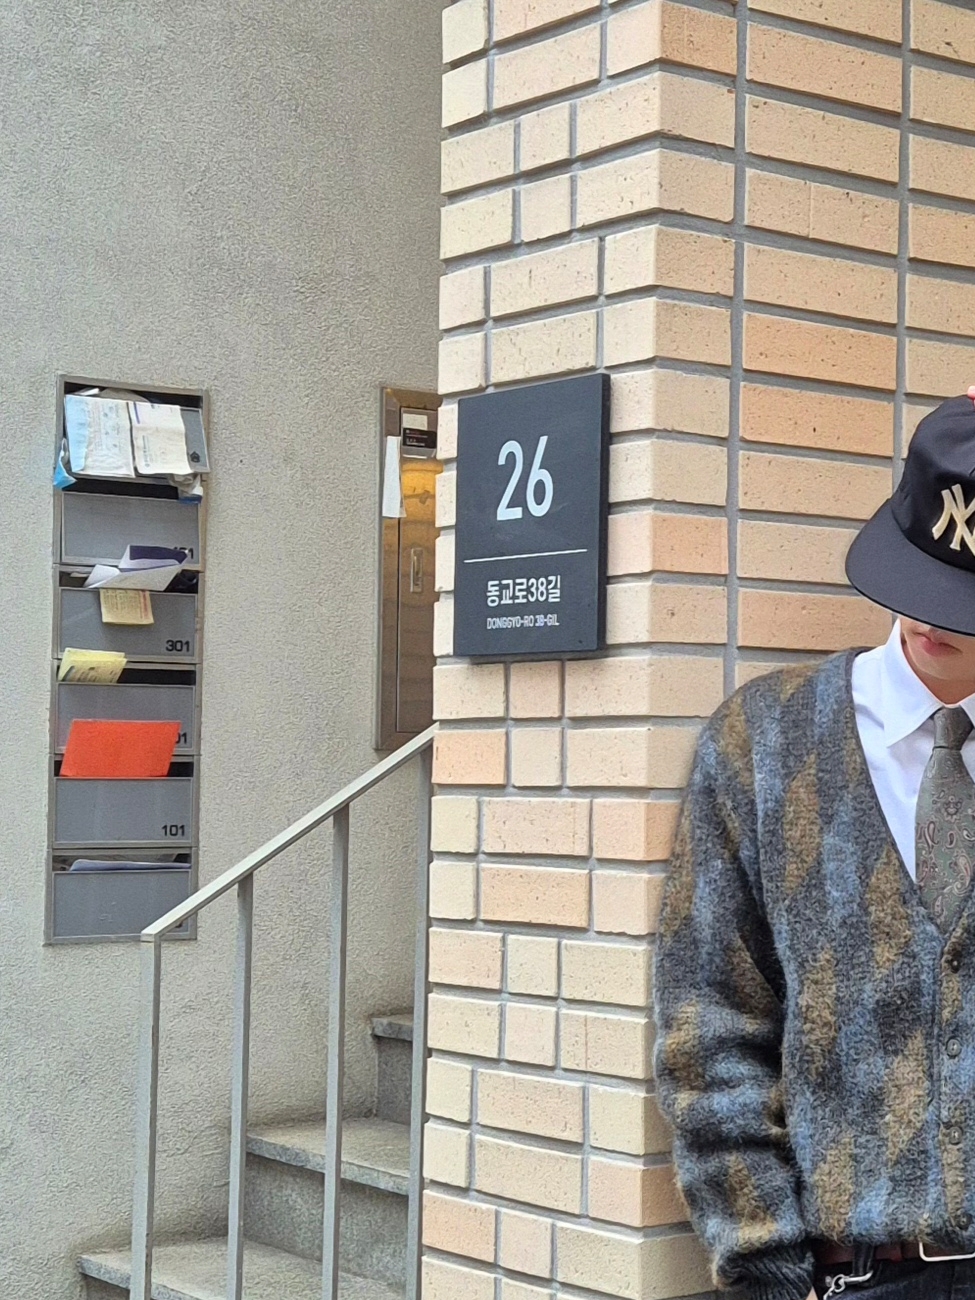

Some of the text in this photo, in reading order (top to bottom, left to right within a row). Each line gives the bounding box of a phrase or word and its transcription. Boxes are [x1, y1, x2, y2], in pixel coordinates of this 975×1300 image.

[497, 435, 553, 521] 26
[486, 575, 561, 607] 동교로38길
[486, 613, 560, 630] DONGGYO-RO 38-GIL
[165, 639, 190, 653] 301
[161, 824, 185, 837] 101
